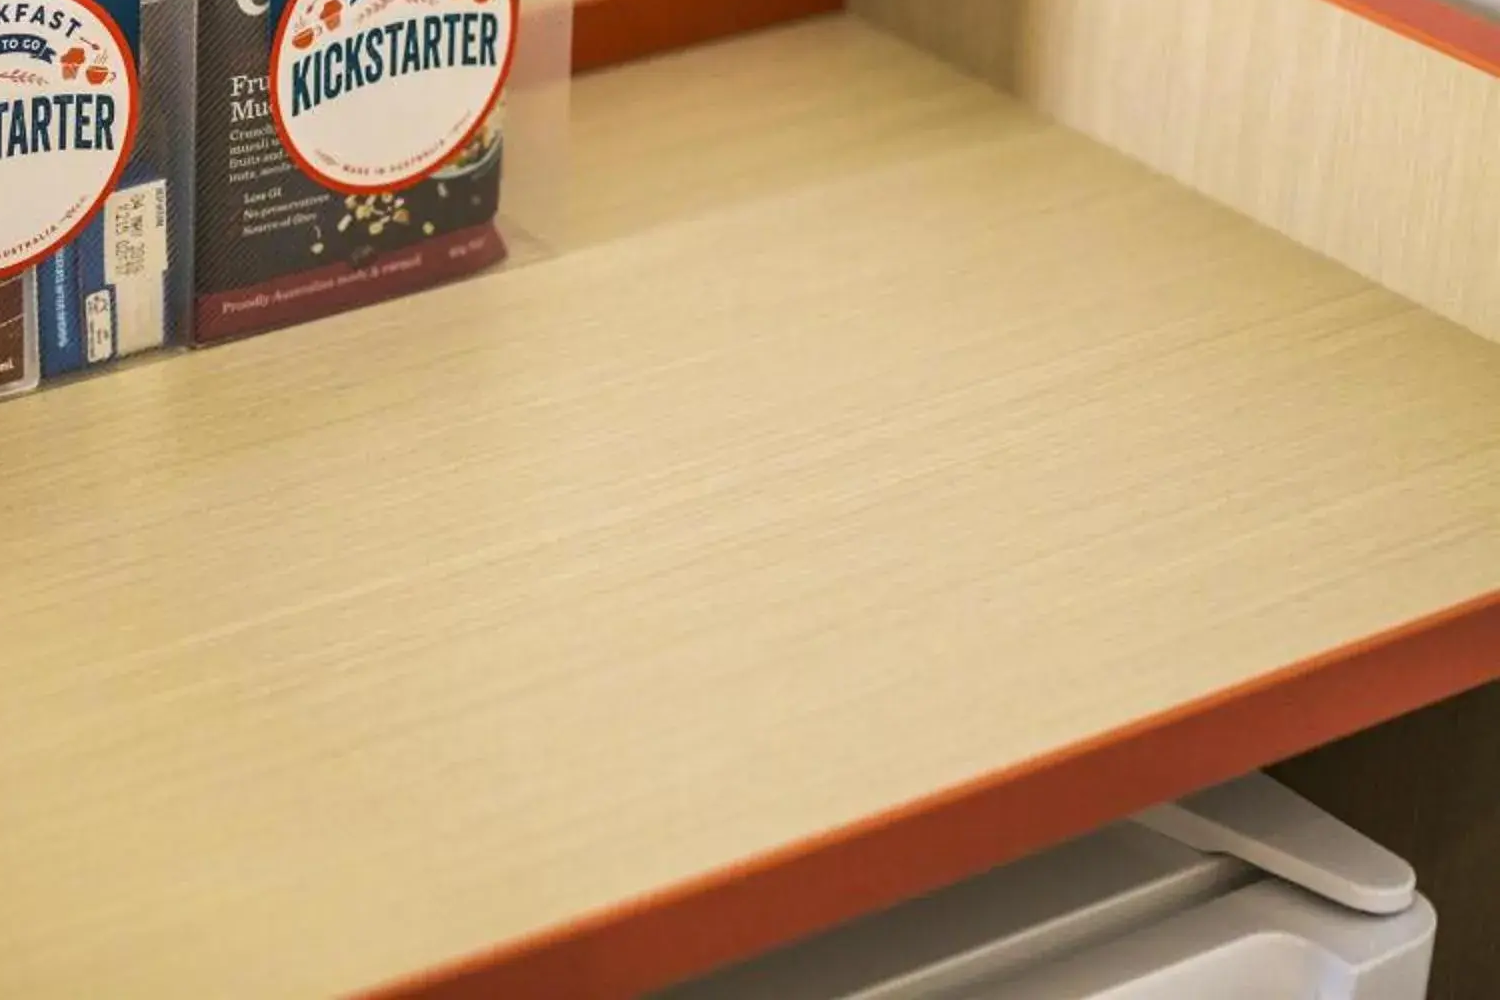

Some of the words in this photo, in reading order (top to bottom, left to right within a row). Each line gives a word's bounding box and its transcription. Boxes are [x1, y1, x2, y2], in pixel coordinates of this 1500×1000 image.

[2, 37, 19, 50] TO
[21, 37, 42, 51] GO
[291, 13, 499, 117] KICKSTARTER
[229, 75, 269, 97] Fru
